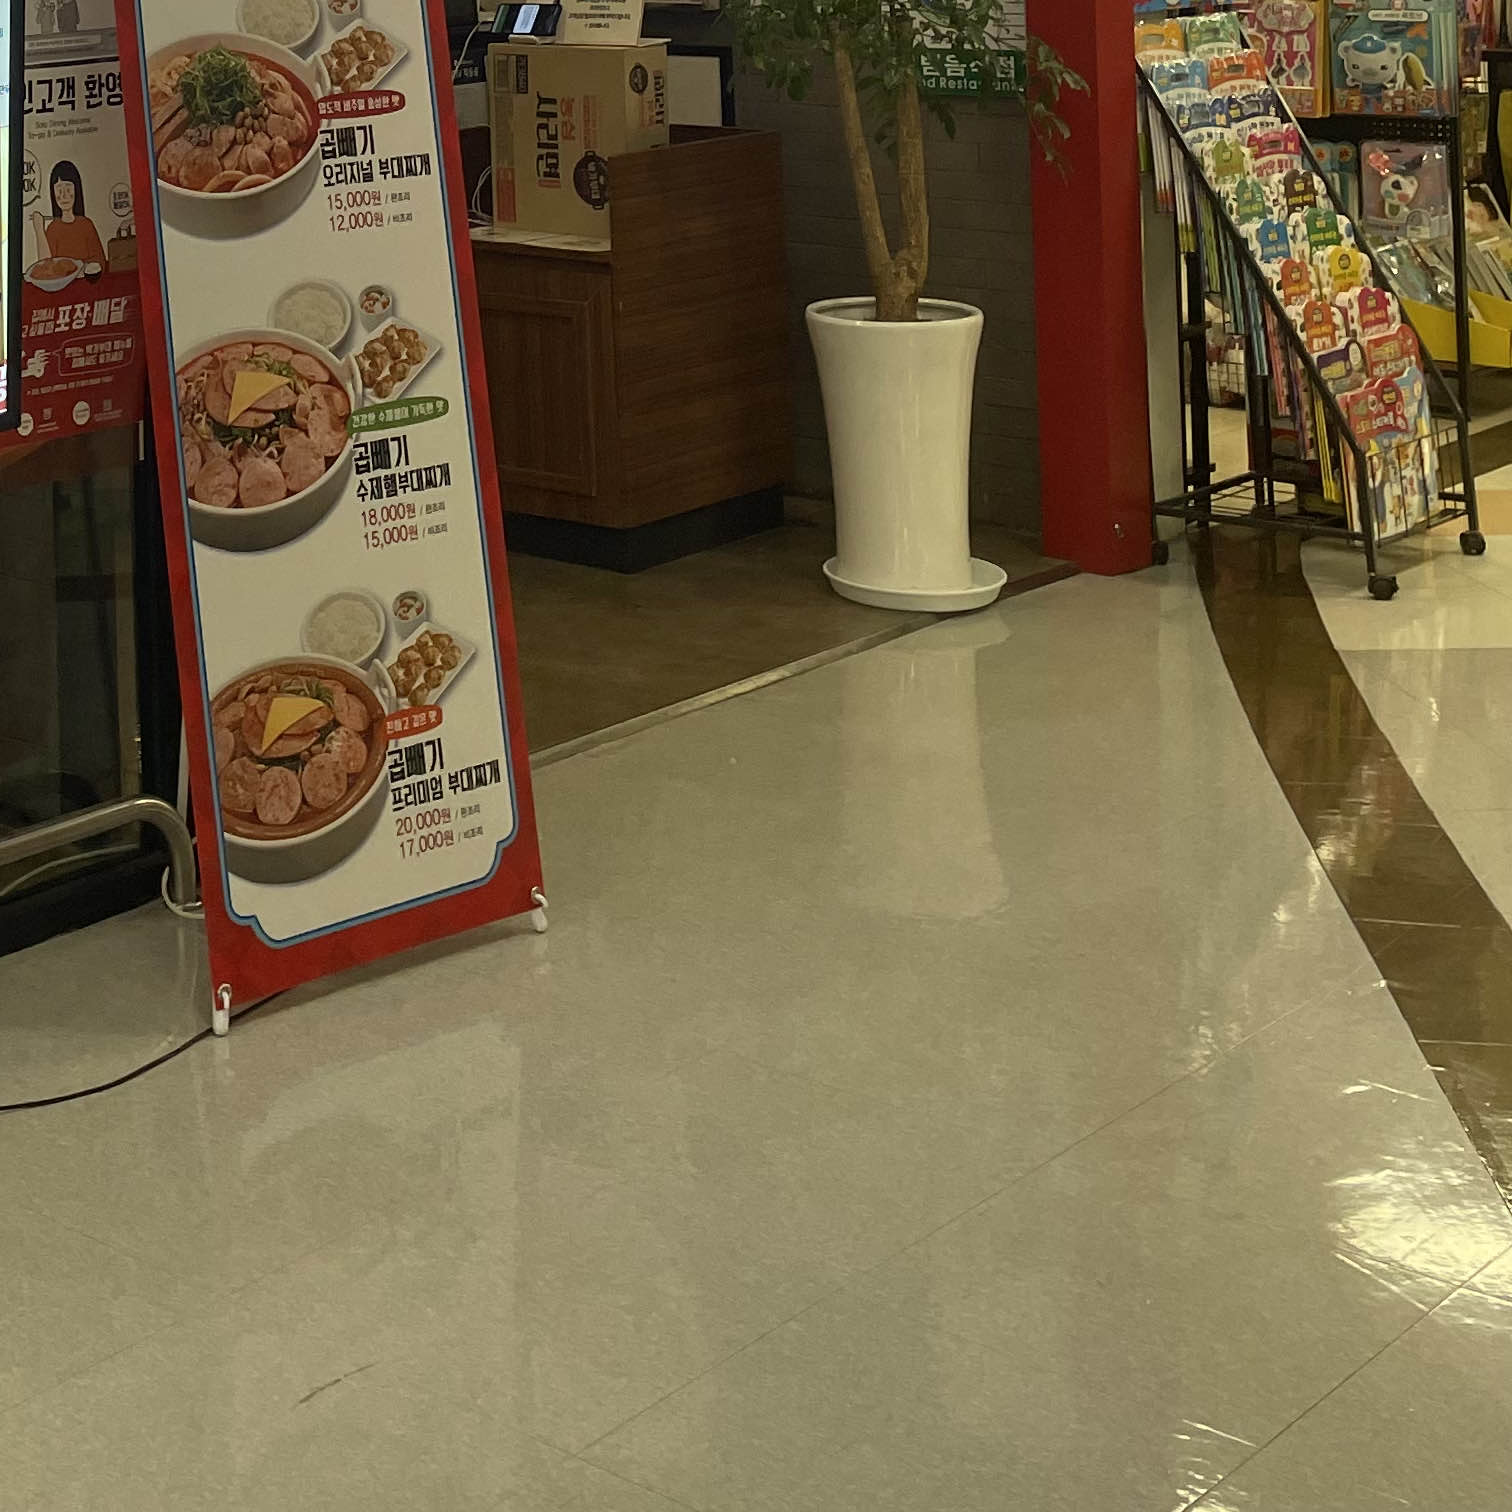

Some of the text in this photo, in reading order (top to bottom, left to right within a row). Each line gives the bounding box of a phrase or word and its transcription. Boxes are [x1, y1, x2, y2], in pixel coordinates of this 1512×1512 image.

[319, 124, 376, 161] 곱빼기
[322, 153, 432, 188] 오리지널 부대찌개
[327, 190, 382, 212] 15,000원
[329, 210, 385, 233] 12,000원
[352, 434, 410, 476] 곱빼기
[356, 462, 452, 503] 수제햄부대찌개
[361, 502, 417, 528] 18,000원
[363, 524, 419, 551] 15,000원
[387, 737, 445, 784] 곱빼기
[390, 758, 502, 813] 프리미엄 부대찌개
[395, 807, 452, 837] 20,000원
[399, 830, 455, 859] 17,000원
